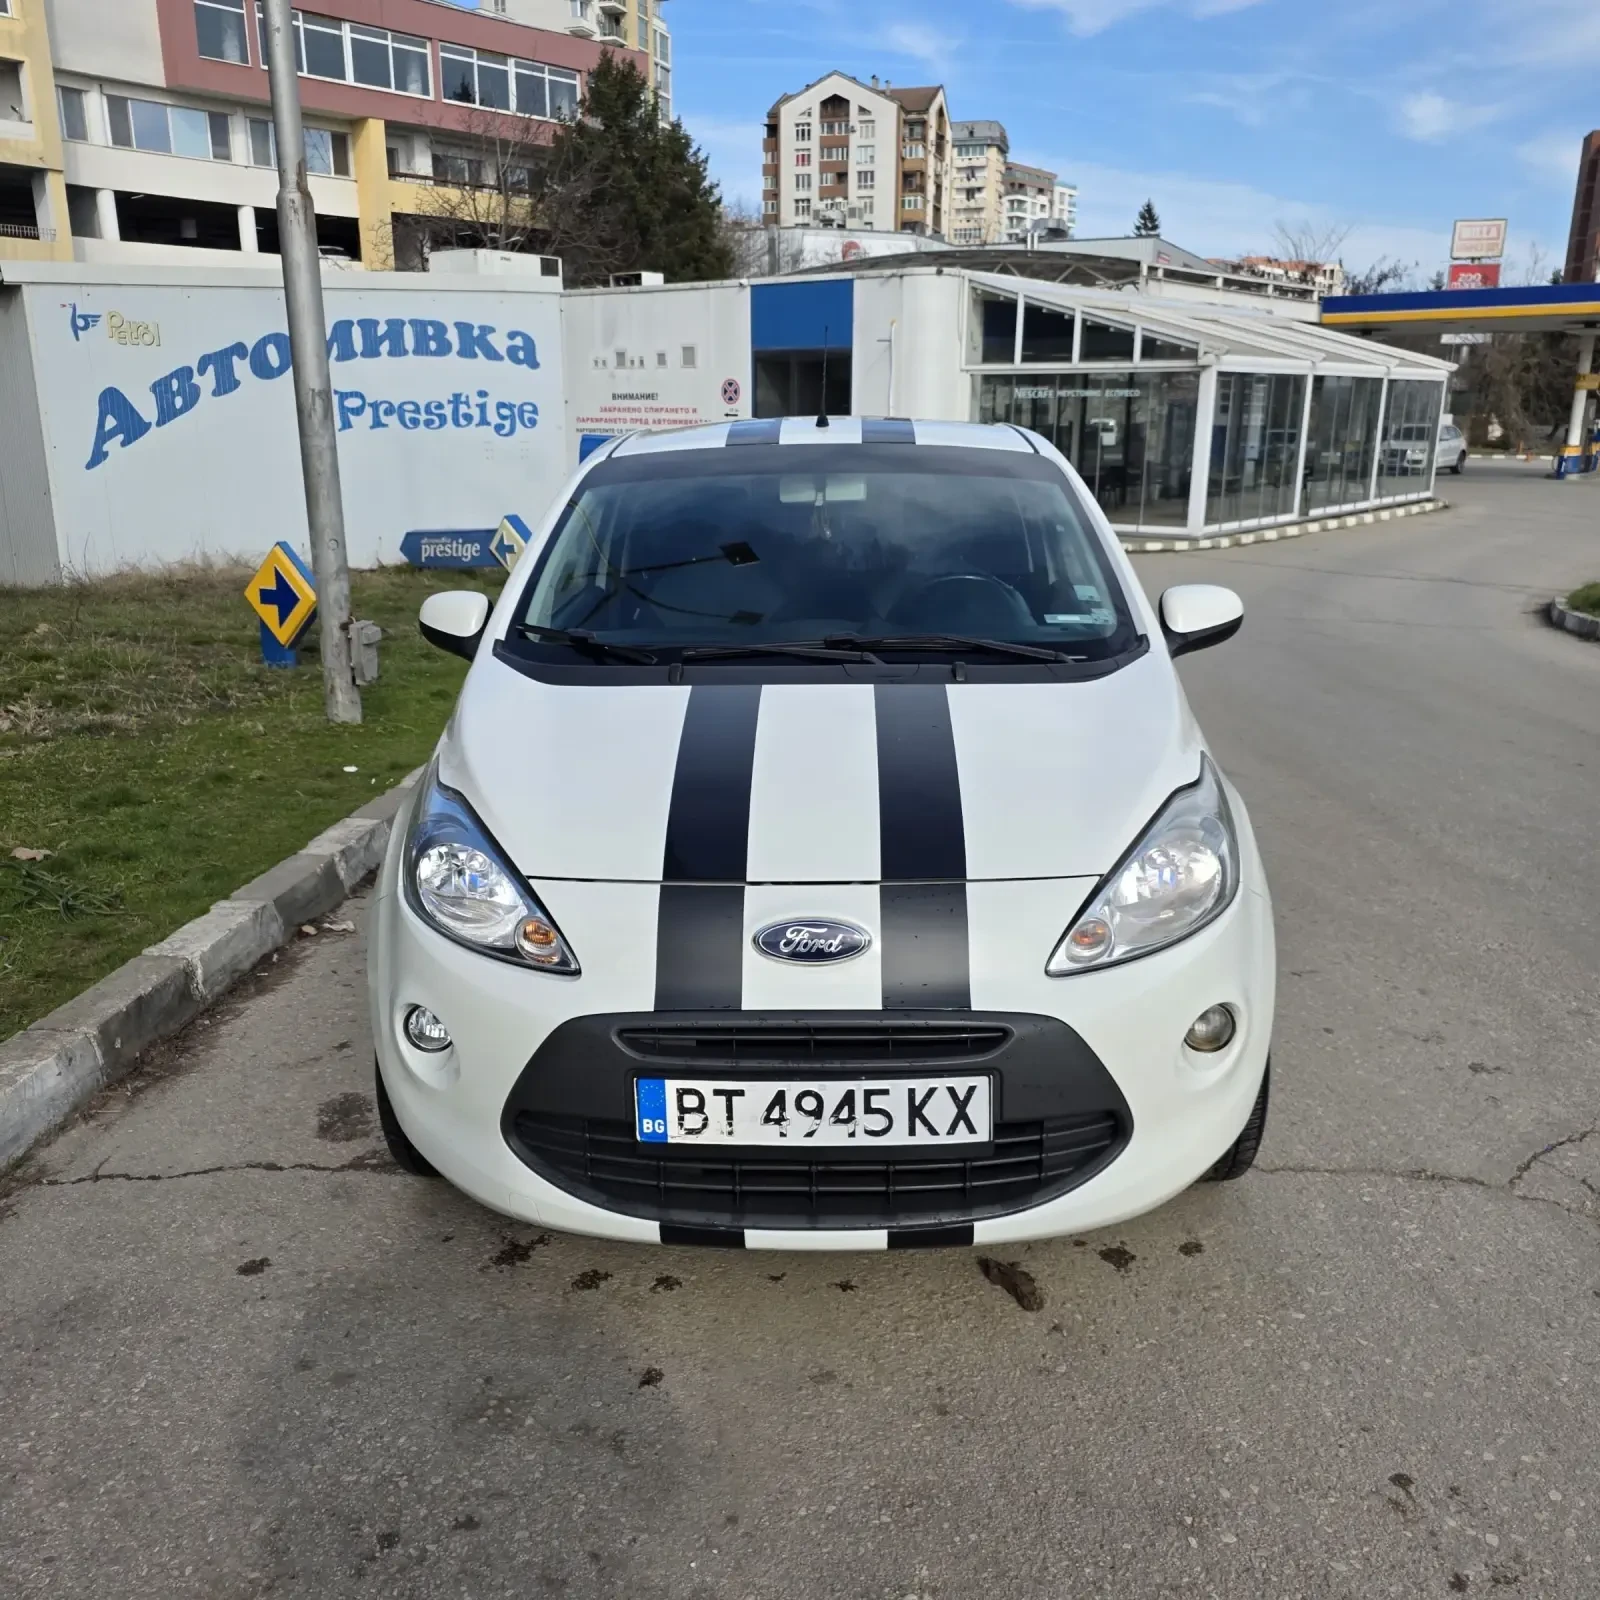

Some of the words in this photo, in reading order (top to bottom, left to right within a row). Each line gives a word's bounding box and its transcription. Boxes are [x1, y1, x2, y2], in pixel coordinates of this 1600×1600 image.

[611, 392, 658, 401] ВНИМАНИЕ!
[333, 389, 540, 438] Prestige
[599, 405, 642, 414] ЗАБРАНЕНО
[644, 406, 690, 415] СПИРАНЕТО
[575, 416, 628, 425] ПАРКИРАНЕТО
[629, 417, 650, 425] ПРЕД
[420, 537, 480, 562] prestige
[779, 926, 844, 954] Ford
[675, 1087, 746, 1137] BT
[760, 1088, 894, 1138] 4945
[907, 1084, 978, 1137] KX
[642, 1118, 665, 1134] BG
